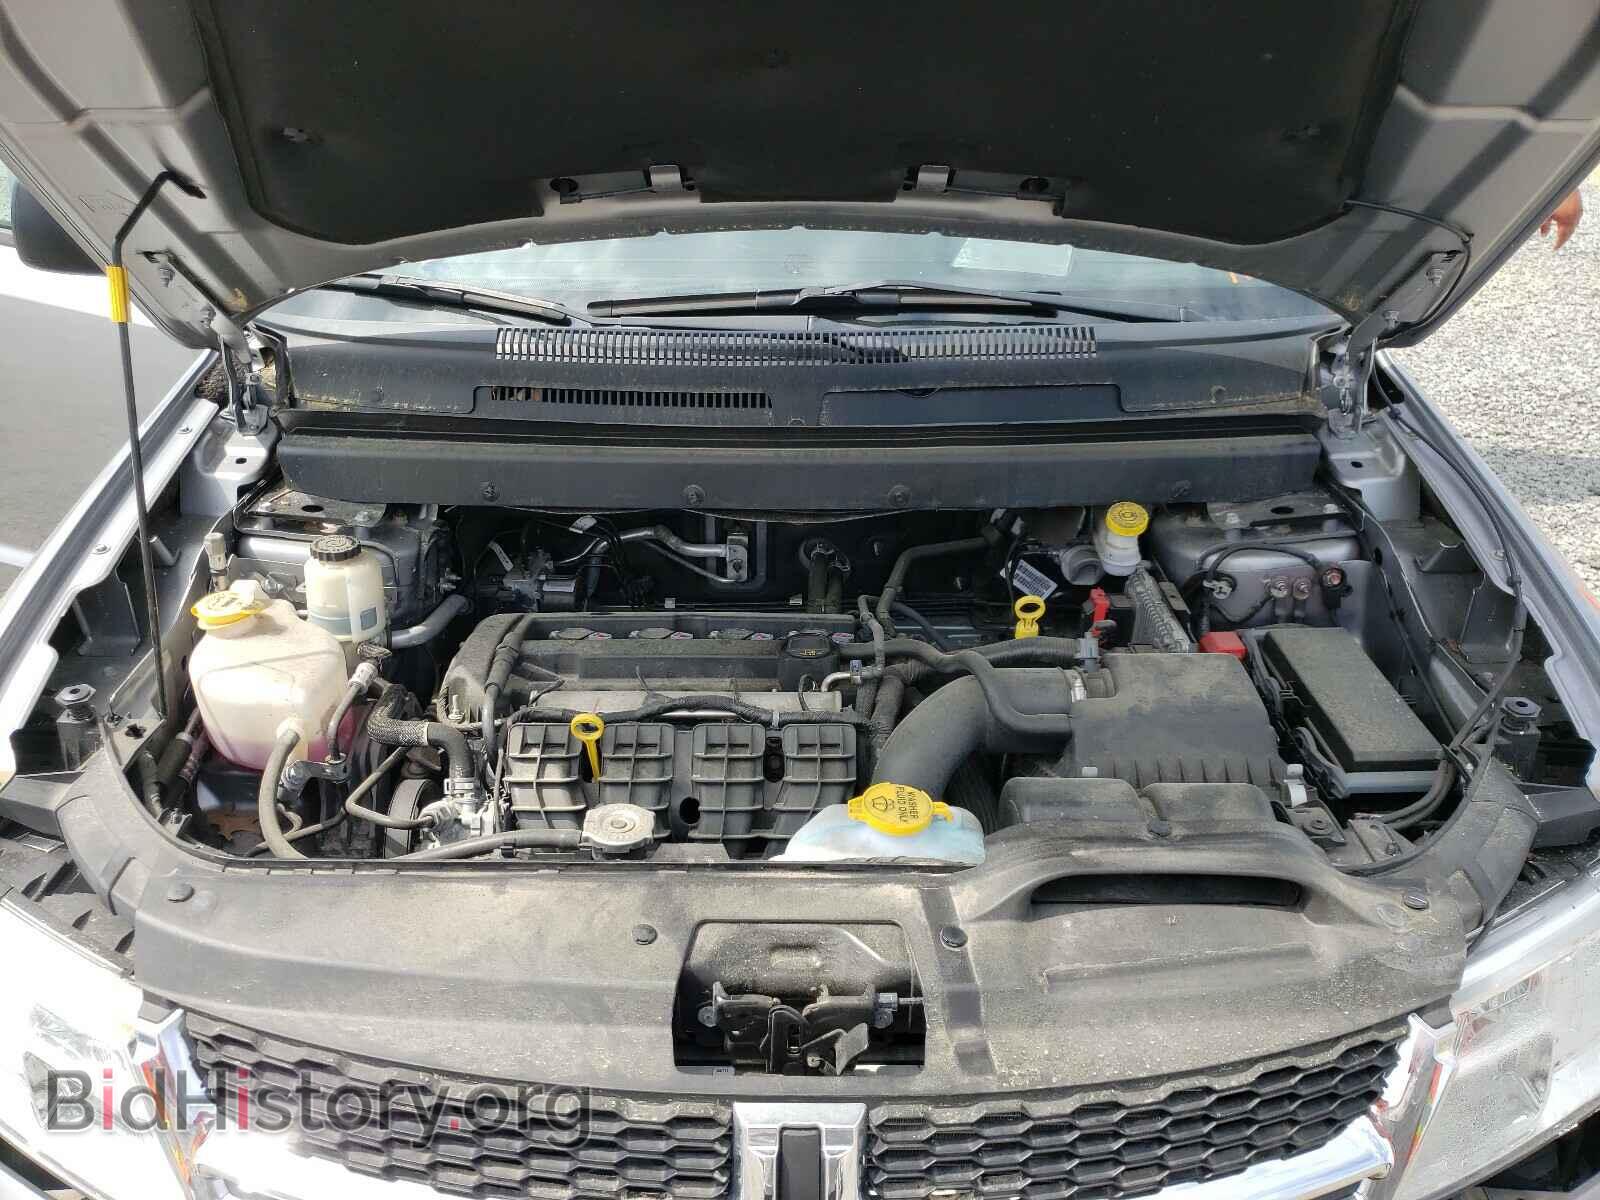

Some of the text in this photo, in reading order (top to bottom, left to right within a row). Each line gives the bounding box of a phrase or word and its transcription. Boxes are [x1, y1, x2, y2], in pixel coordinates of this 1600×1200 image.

[895, 786, 909, 823] FLUID ONLY
[907, 791, 919, 819] WASHER
